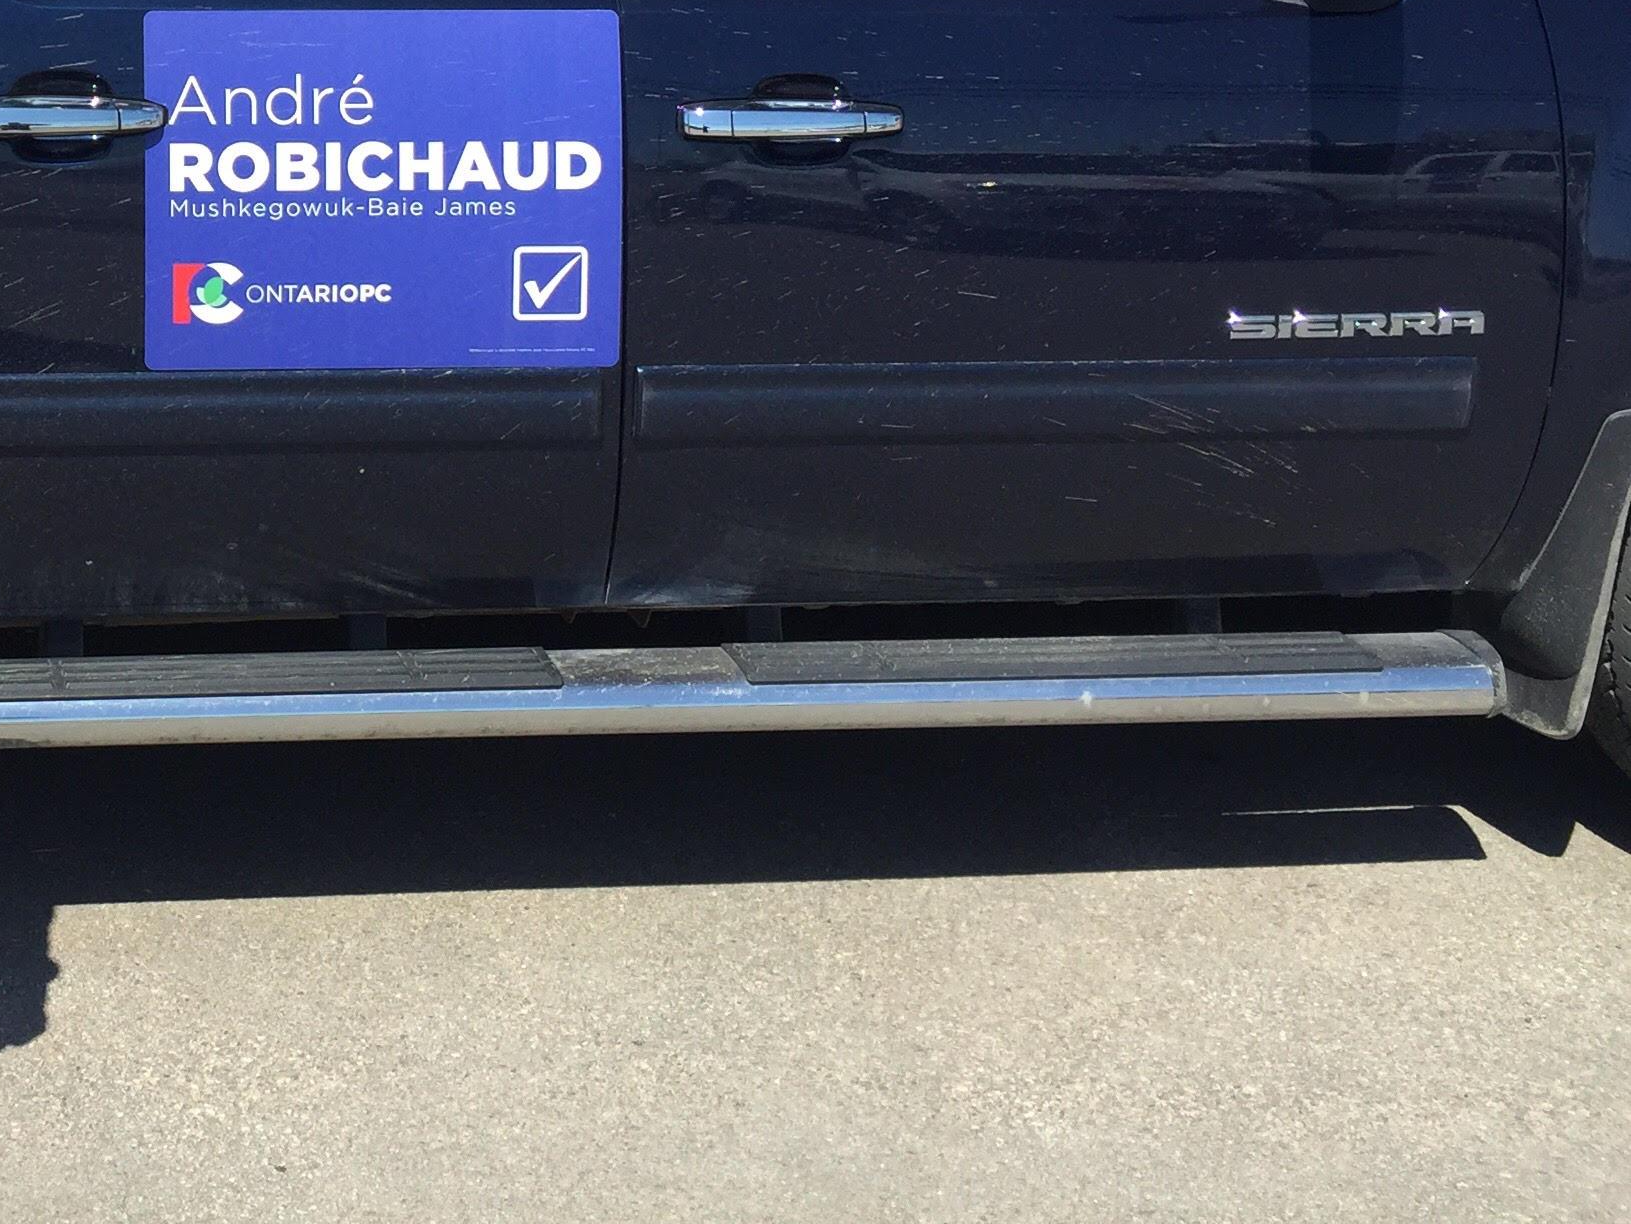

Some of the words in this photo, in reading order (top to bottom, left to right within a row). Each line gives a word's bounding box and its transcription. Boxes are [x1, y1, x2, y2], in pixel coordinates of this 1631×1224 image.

[168, 72, 375, 126] André
[169, 141, 603, 193] ROBICHAUD
[170, 197, 424, 221] Mushkegowuk-Baie
[434, 196, 517, 217] James
[245, 284, 393, 304] ONTARIOPC
[1227, 309, 1486, 339] SIERRA
